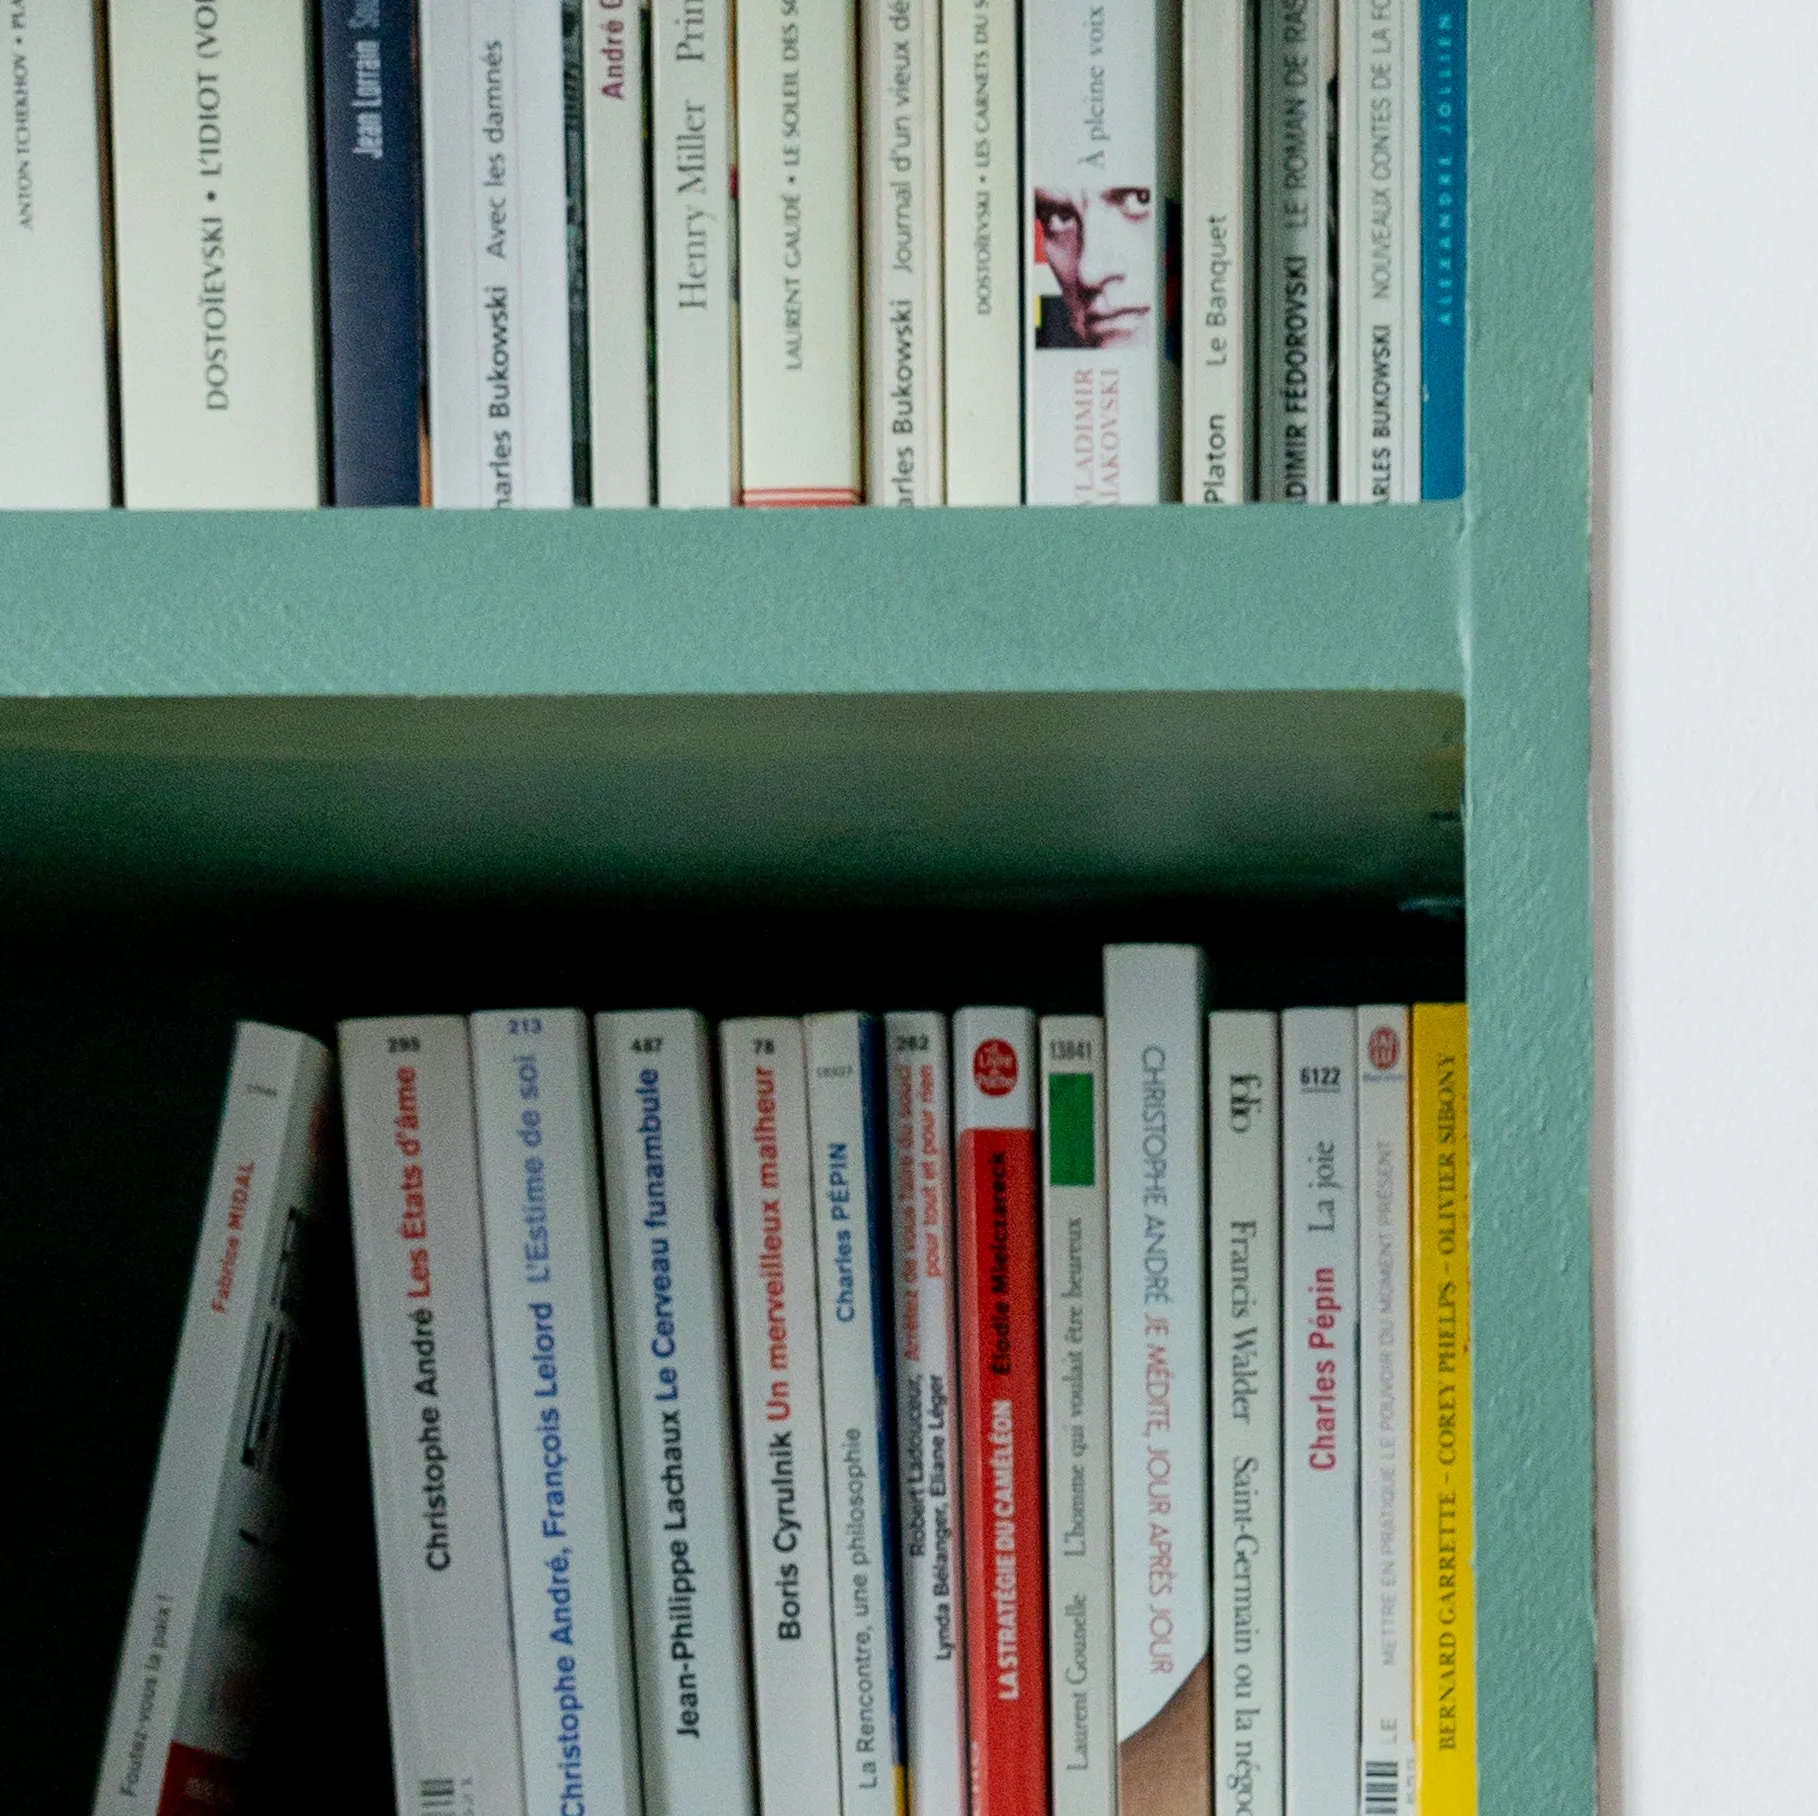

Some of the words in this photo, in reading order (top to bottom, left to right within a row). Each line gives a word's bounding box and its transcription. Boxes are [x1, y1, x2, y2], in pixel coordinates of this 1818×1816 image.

[352, 40, 381, 107] Lorrain
[479, 40, 504, 143] damnés
[889, 41, 910, 103] vieux
[1437, 12, 1452, 135] JOLLIEN
[354, 115, 383, 159] Jean
[483, 154, 506, 185] les
[677, 99, 706, 195] Miller
[888, 116, 911, 172] d'un
[485, 197, 506, 259] Avec
[678, 206, 716, 309] Henry
[781, 195, 800, 268] GAUDÉ
[889, 183, 912, 274] Journal
[1206, 214, 1232, 327] Banquet
[1437, 155, 1454, 325] ALEXANDRE
[198, 217, 229, 411] DOSTOÏEVSKI
[485, 286, 511, 417] Bukowski
[784, 278, 802, 369] LAURENT
[1206, 337, 1226, 365] Le
[1280, 257, 1307, 413] FÉDOROVSKI
[889, 300, 913, 434] Bukowski
[1372, 325, 1391, 437] BUKOWSKI
[1204, 415, 1225, 503] Platon
[395, 1067, 421, 1156] d'âme
[513, 1055, 539, 1100] soi
[1299, 1067, 1340, 1084] 6122
[1438, 1052, 1456, 1144] SIBONY
[519, 1110, 543, 1146] de
[636, 1069, 667, 1228] funambule
[754, 1067, 779, 1189] malheur
[1310, 1140, 1342, 1190] joie
[395, 1165, 427, 1239] États
[522, 1157, 550, 1283] L'Estime
[1310, 1200, 1336, 1232] La
[1438, 1153, 1456, 1255] OLIVIER
[406, 1249, 432, 1298] Les
[650, 1238, 675, 1358] Cerveau
[758, 1200, 788, 1371] merveilleux
[1307, 1267, 1342, 1349] Pépin
[409, 1309, 438, 1397] André
[530, 1303, 558, 1397] Lelord
[1438, 1280, 1456, 1372] PHELPS
[655, 1367, 678, 1401] Le
[766, 1380, 791, 1421] Un
[1307, 1360, 1336, 1470] Charles
[1439, 1383, 1456, 1465] COREY
[413, 1407, 453, 1572] Christophe
[535, 1408, 568, 1538] François
[658, 1410, 687, 1530] Lachaux
[768, 1432, 803, 1553] Cyrulnik
[842, 1428, 872, 1565] philosophie
[990, 1399, 1016, 1518] CAMÉLÉON
[996, 1522, 1015, 1550] DU
[1232, 1455, 1259, 1652] Saint-Germain
[1439, 1492, 1456, 1619] GARRETTE
[545, 1547, 575, 1646] André,
[664, 1540, 702, 1739] Jean-Philippe
[777, 1564, 800, 1639] Boris
[852, 1573, 869, 1615] une
[994, 1555, 1019, 1667] STRATÉGIE
[854, 1625, 876, 1752] Rencontre,
[997, 1672, 1019, 1699] LA
[1233, 1664, 1253, 1699] ou
[1233, 1708, 1259, 1730] la
[1439, 1628, 1457, 1750] BERNARD
[859, 1761, 878, 1789] La
